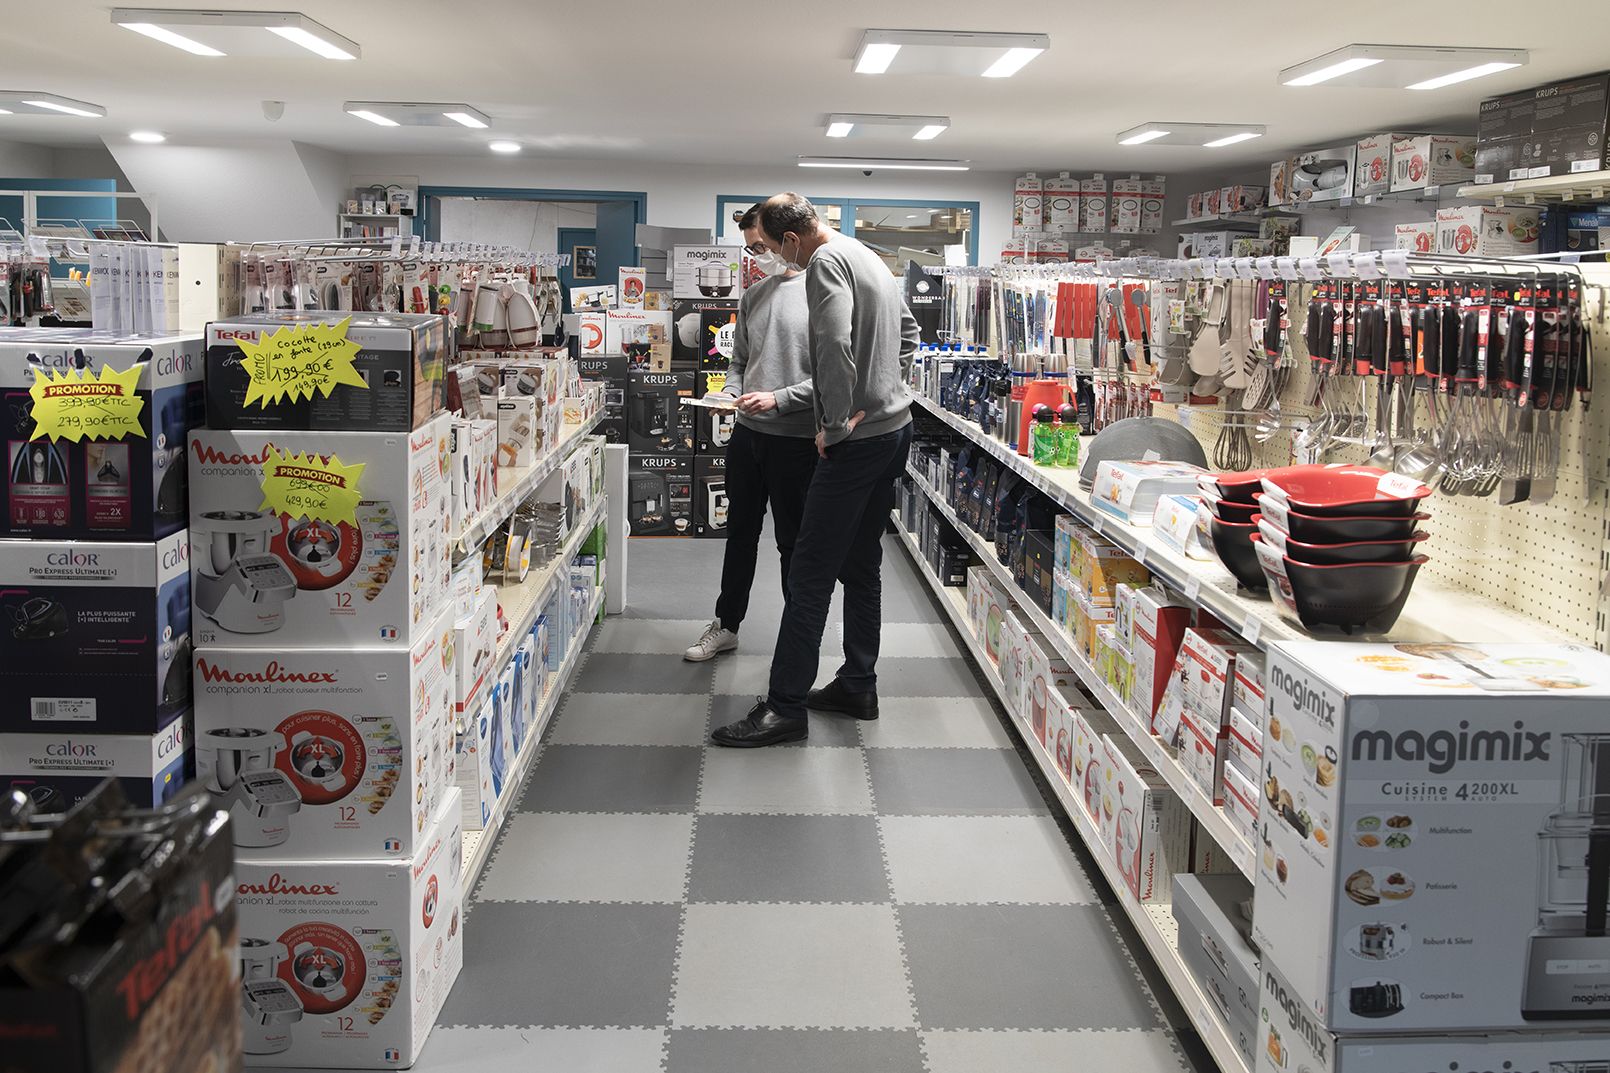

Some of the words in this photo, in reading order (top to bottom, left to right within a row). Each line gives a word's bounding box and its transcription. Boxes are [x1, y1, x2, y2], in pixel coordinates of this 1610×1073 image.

[1536, 87, 1558, 98] KRUPS
[1480, 100, 1500, 112] KRUPS
[1358, 142, 1378, 150] Moulinex
[1394, 144, 1416, 154] Moulinex
[1438, 212, 1464, 221] Moulinex
[686, 250, 726, 260] magimix
[1426, 288, 1450, 296] Tefal
[1470, 288, 1486, 297] Tefal
[607, 311, 646, 320] Moulinex
[214, 329, 258, 340] Tefal
[254, 354, 266, 385] PROMO
[581, 361, 608, 370] RUPS
[643, 375, 678, 384] KRUPS
[49, 384, 116, 396] PROMOTION
[411, 434, 432, 453] Moulinex
[642, 458, 677, 467] KRUPS
[201, 467, 256, 477] companion
[280, 468, 340, 484] PROMOTION
[1111, 469, 1124, 481] Tefal
[1390, 480, 1408, 491] Tefal
[110, 508, 121, 516] 2X
[1266, 507, 1282, 522] Tefal
[307, 528, 322, 538] XL
[1262, 554, 1278, 569] Tefal
[335, 593, 352, 607] 12
[199, 634, 209, 642] 10
[413, 639, 435, 667] Moulinex
[1196, 641, 1208, 655] Tefal
[196, 658, 338, 683] Moulinex
[206, 685, 260, 695] companion
[1272, 665, 1335, 728] magimix
[281, 720, 294, 734] pour
[296, 715, 321, 724] cuisiner
[338, 723, 351, 737] sans
[310, 744, 325, 754] XL
[1352, 720, 1551, 774] magimix
[1382, 782, 1448, 795] Cuisine
[339, 807, 355, 820] 12
[414, 839, 440, 880] Moulinex
[1142, 851, 1154, 900] Moulinex
[237, 873, 339, 895] oulinex
[236, 896, 263, 905] anion
[116, 880, 214, 1020] Tefal
[312, 955, 326, 964] XL
[337, 1017, 354, 1030] 12
[1266, 972, 1326, 1064] magimix
